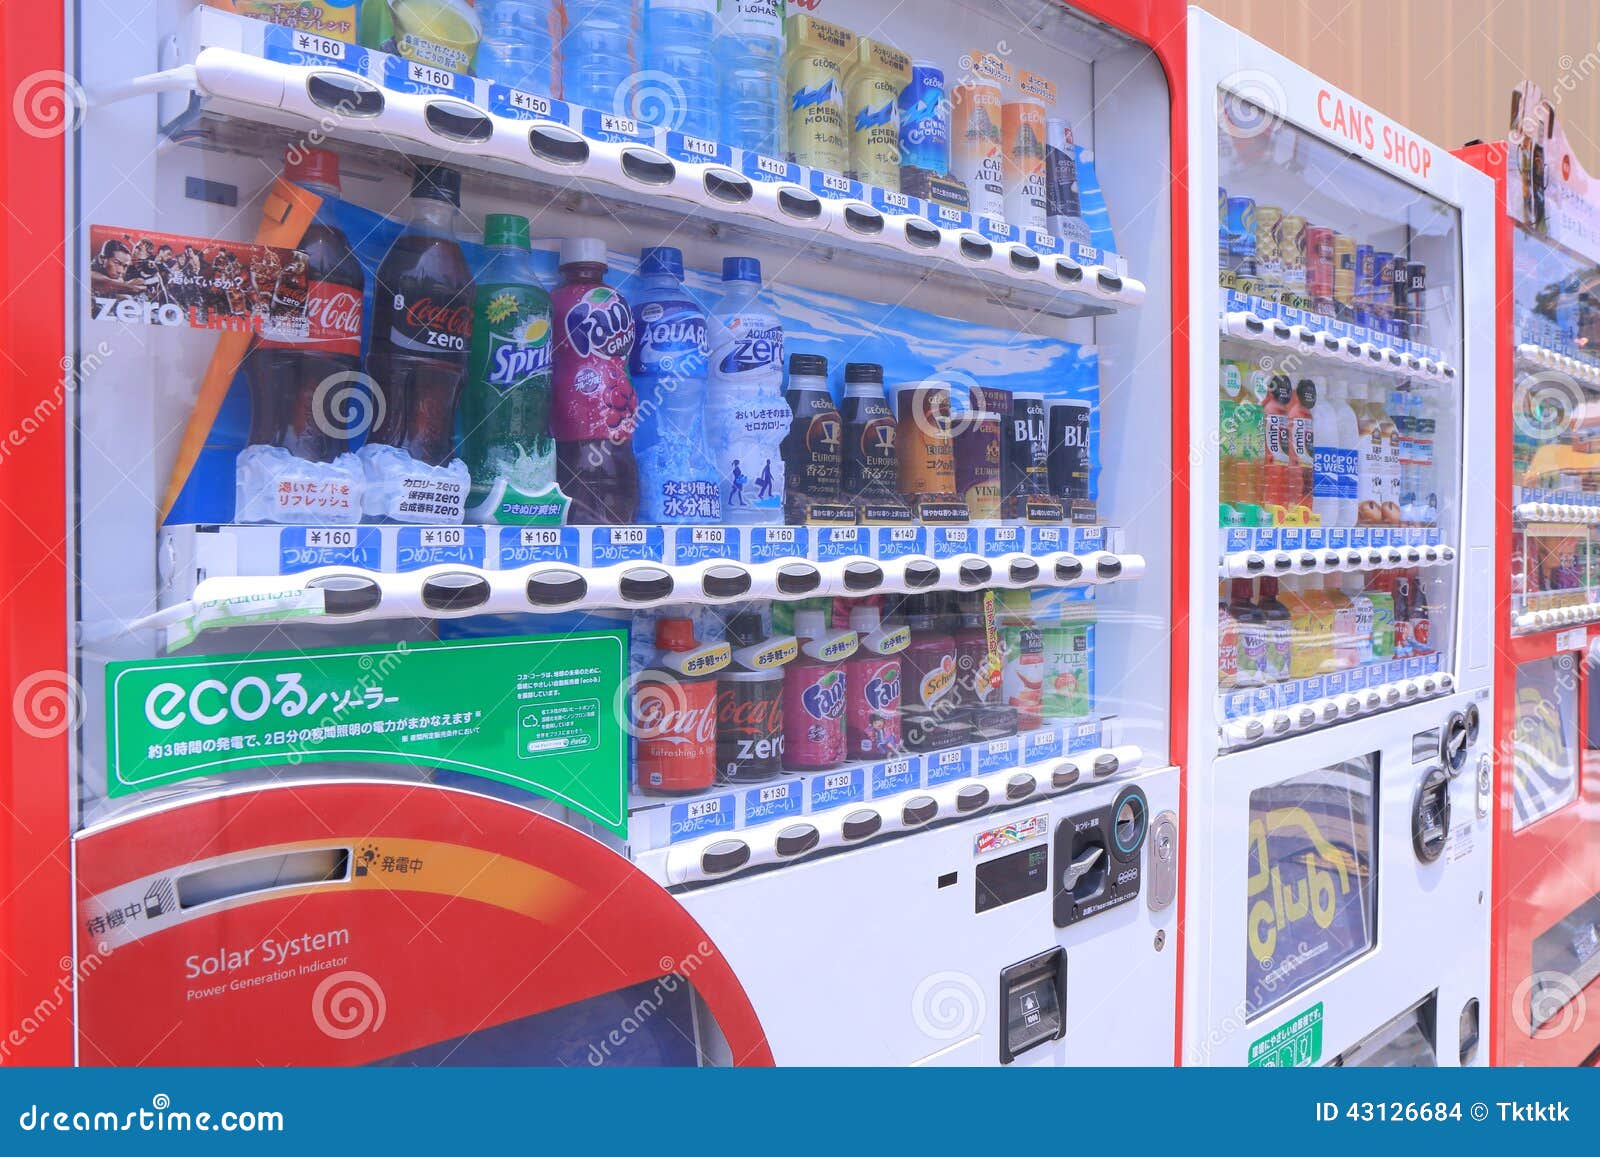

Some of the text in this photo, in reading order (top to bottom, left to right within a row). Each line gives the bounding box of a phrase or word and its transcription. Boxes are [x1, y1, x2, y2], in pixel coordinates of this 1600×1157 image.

[273, 4, 322, 19] すっきり
[299, 35, 341, 56] ¥160
[414, 64, 449, 86] ¥160
[515, 93, 547, 113] ¥150
[605, 117, 635, 132] ¥150
[1317, 89, 1432, 179] CANS SHOP
[687, 138, 714, 155] ¥110
[760, 159, 785, 175] ¥110
[93, 297, 183, 326] zero
[426, 330, 464, 351] zero
[1014, 419, 1045, 442] BLA
[402, 478, 460, 493] カロリーzero
[279, 495, 349, 509] リフレッシュ
[311, 531, 351, 546] ¥160
[424, 530, 460, 544] ¥160
[524, 531, 557, 543] ¥160
[614, 530, 643, 542] ¥160
[695, 530, 722, 541] ¥160
[768, 530, 792, 541] ¥160
[833, 529, 856, 540] ¥140
[894, 529, 914, 539] ¥140
[887, 763, 908, 774] ¥130
[826, 775, 849, 788] ¥130
[761, 787, 786, 800] ¥130
[691, 801, 718, 817] ¥130
[382, 857, 424, 873] 発電中
[87, 903, 144, 938] 待機中
[186, 927, 350, 980] Solar System
[187, 954, 349, 1001] Power Generation Indicator
